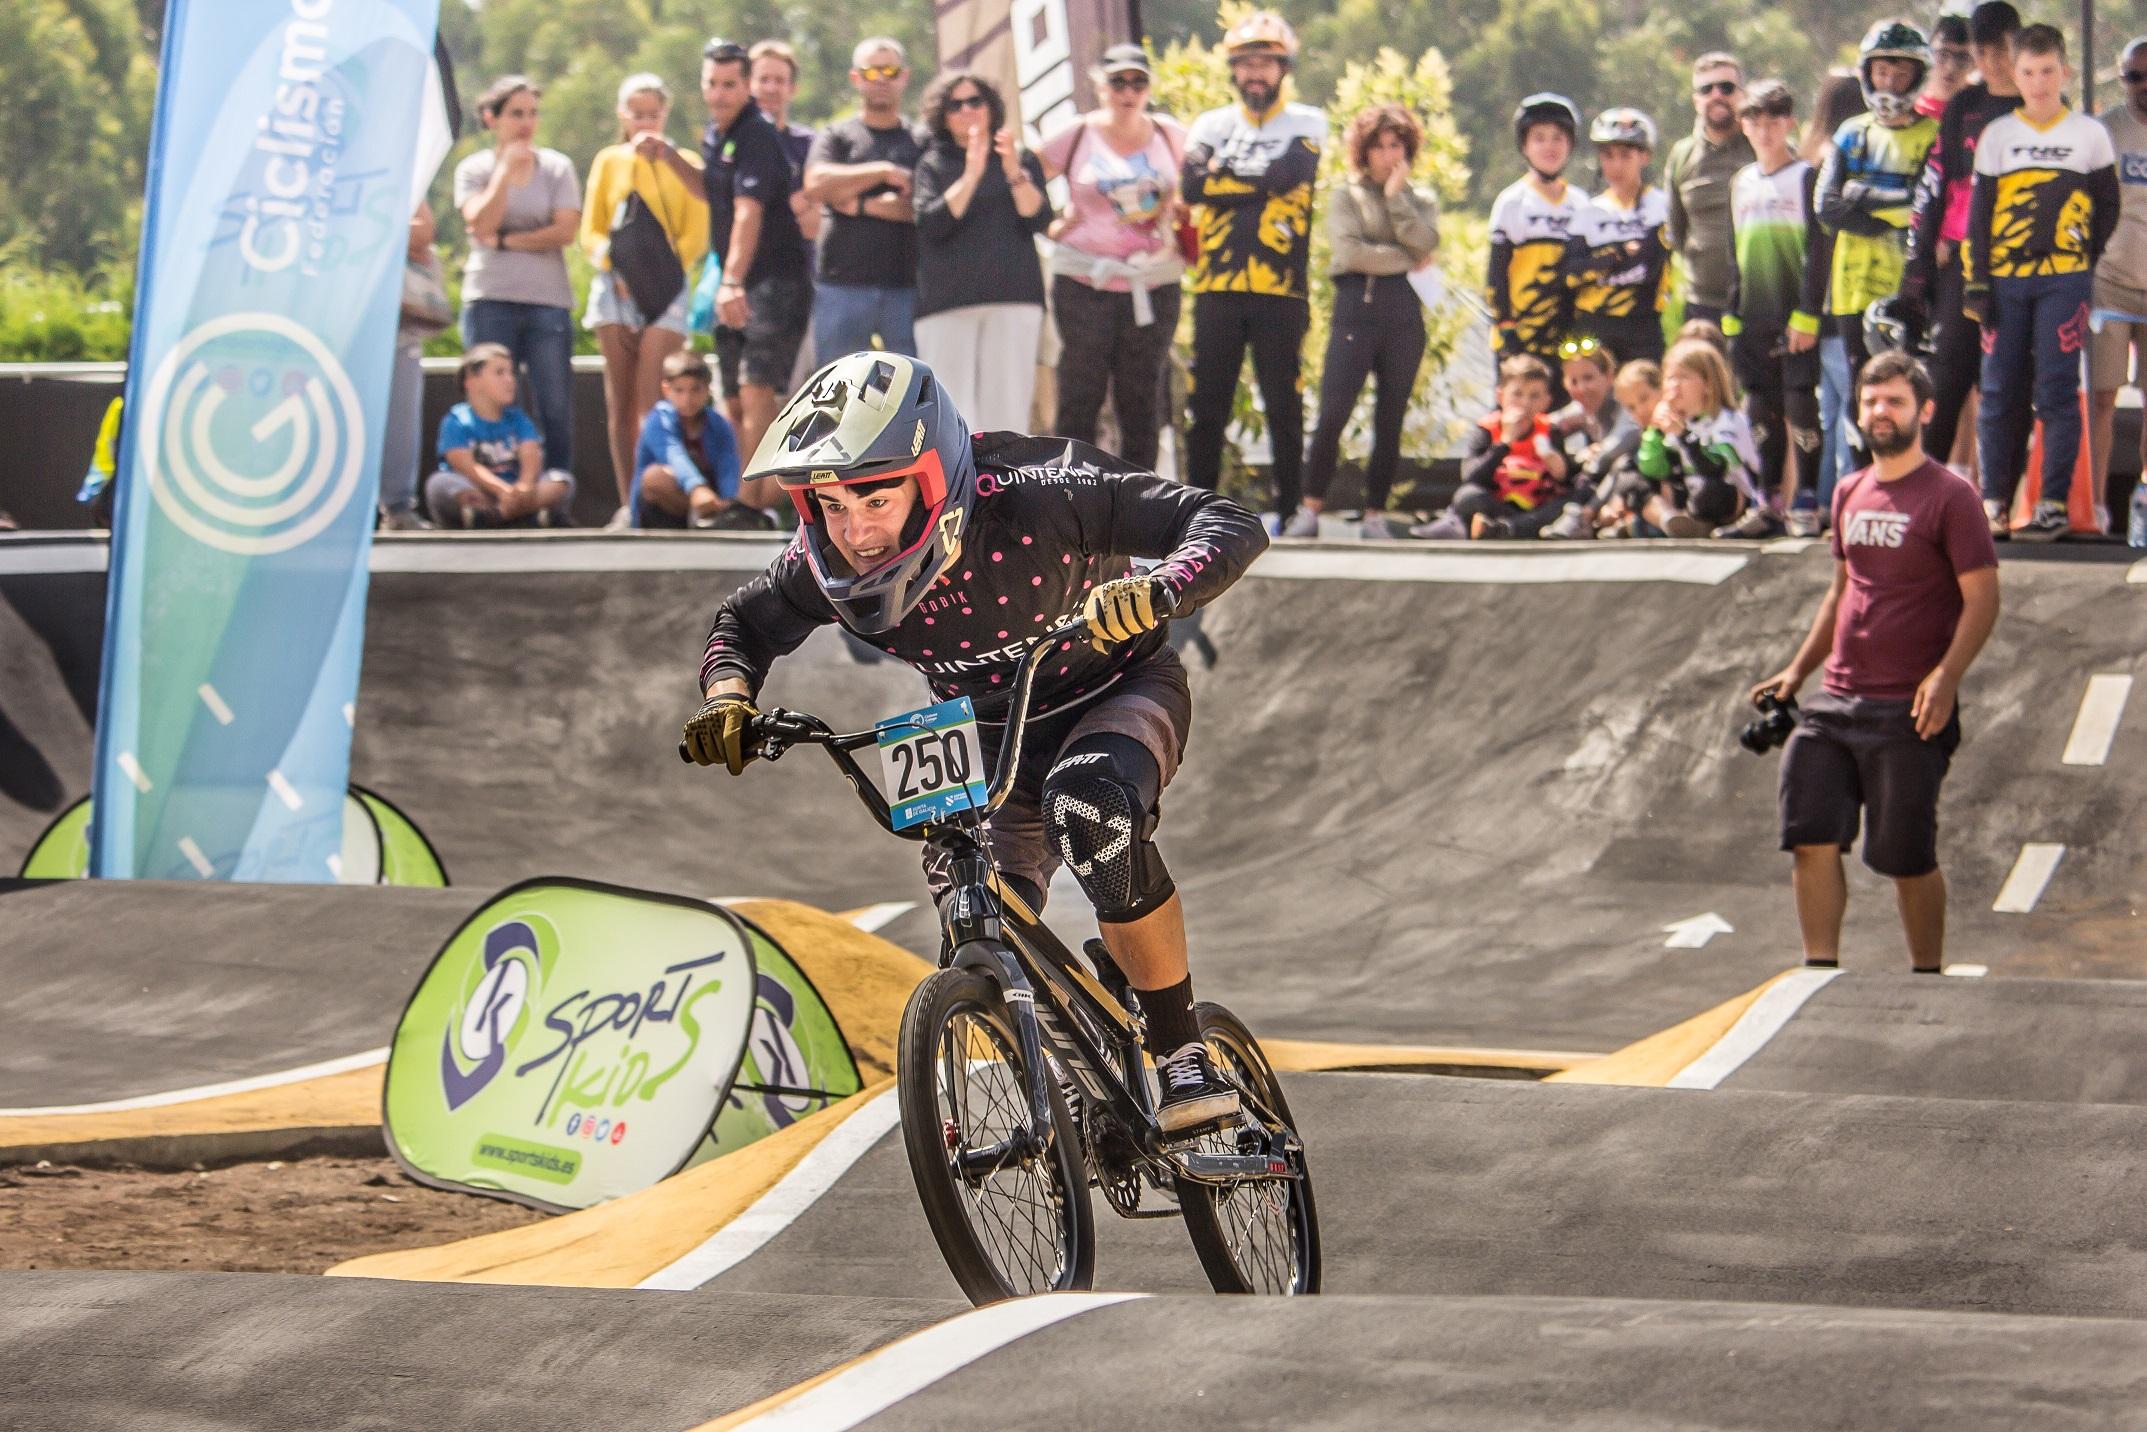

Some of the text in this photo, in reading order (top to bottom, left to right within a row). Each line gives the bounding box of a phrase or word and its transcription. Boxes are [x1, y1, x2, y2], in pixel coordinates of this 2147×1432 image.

[813, 472, 832, 480] LEATT
[1041, 477, 1070, 486] DESDE
[1843, 509, 1911, 548] VANS
[891, 729, 970, 800] 250
[479, 1144, 576, 1174] www.sportskids.es
